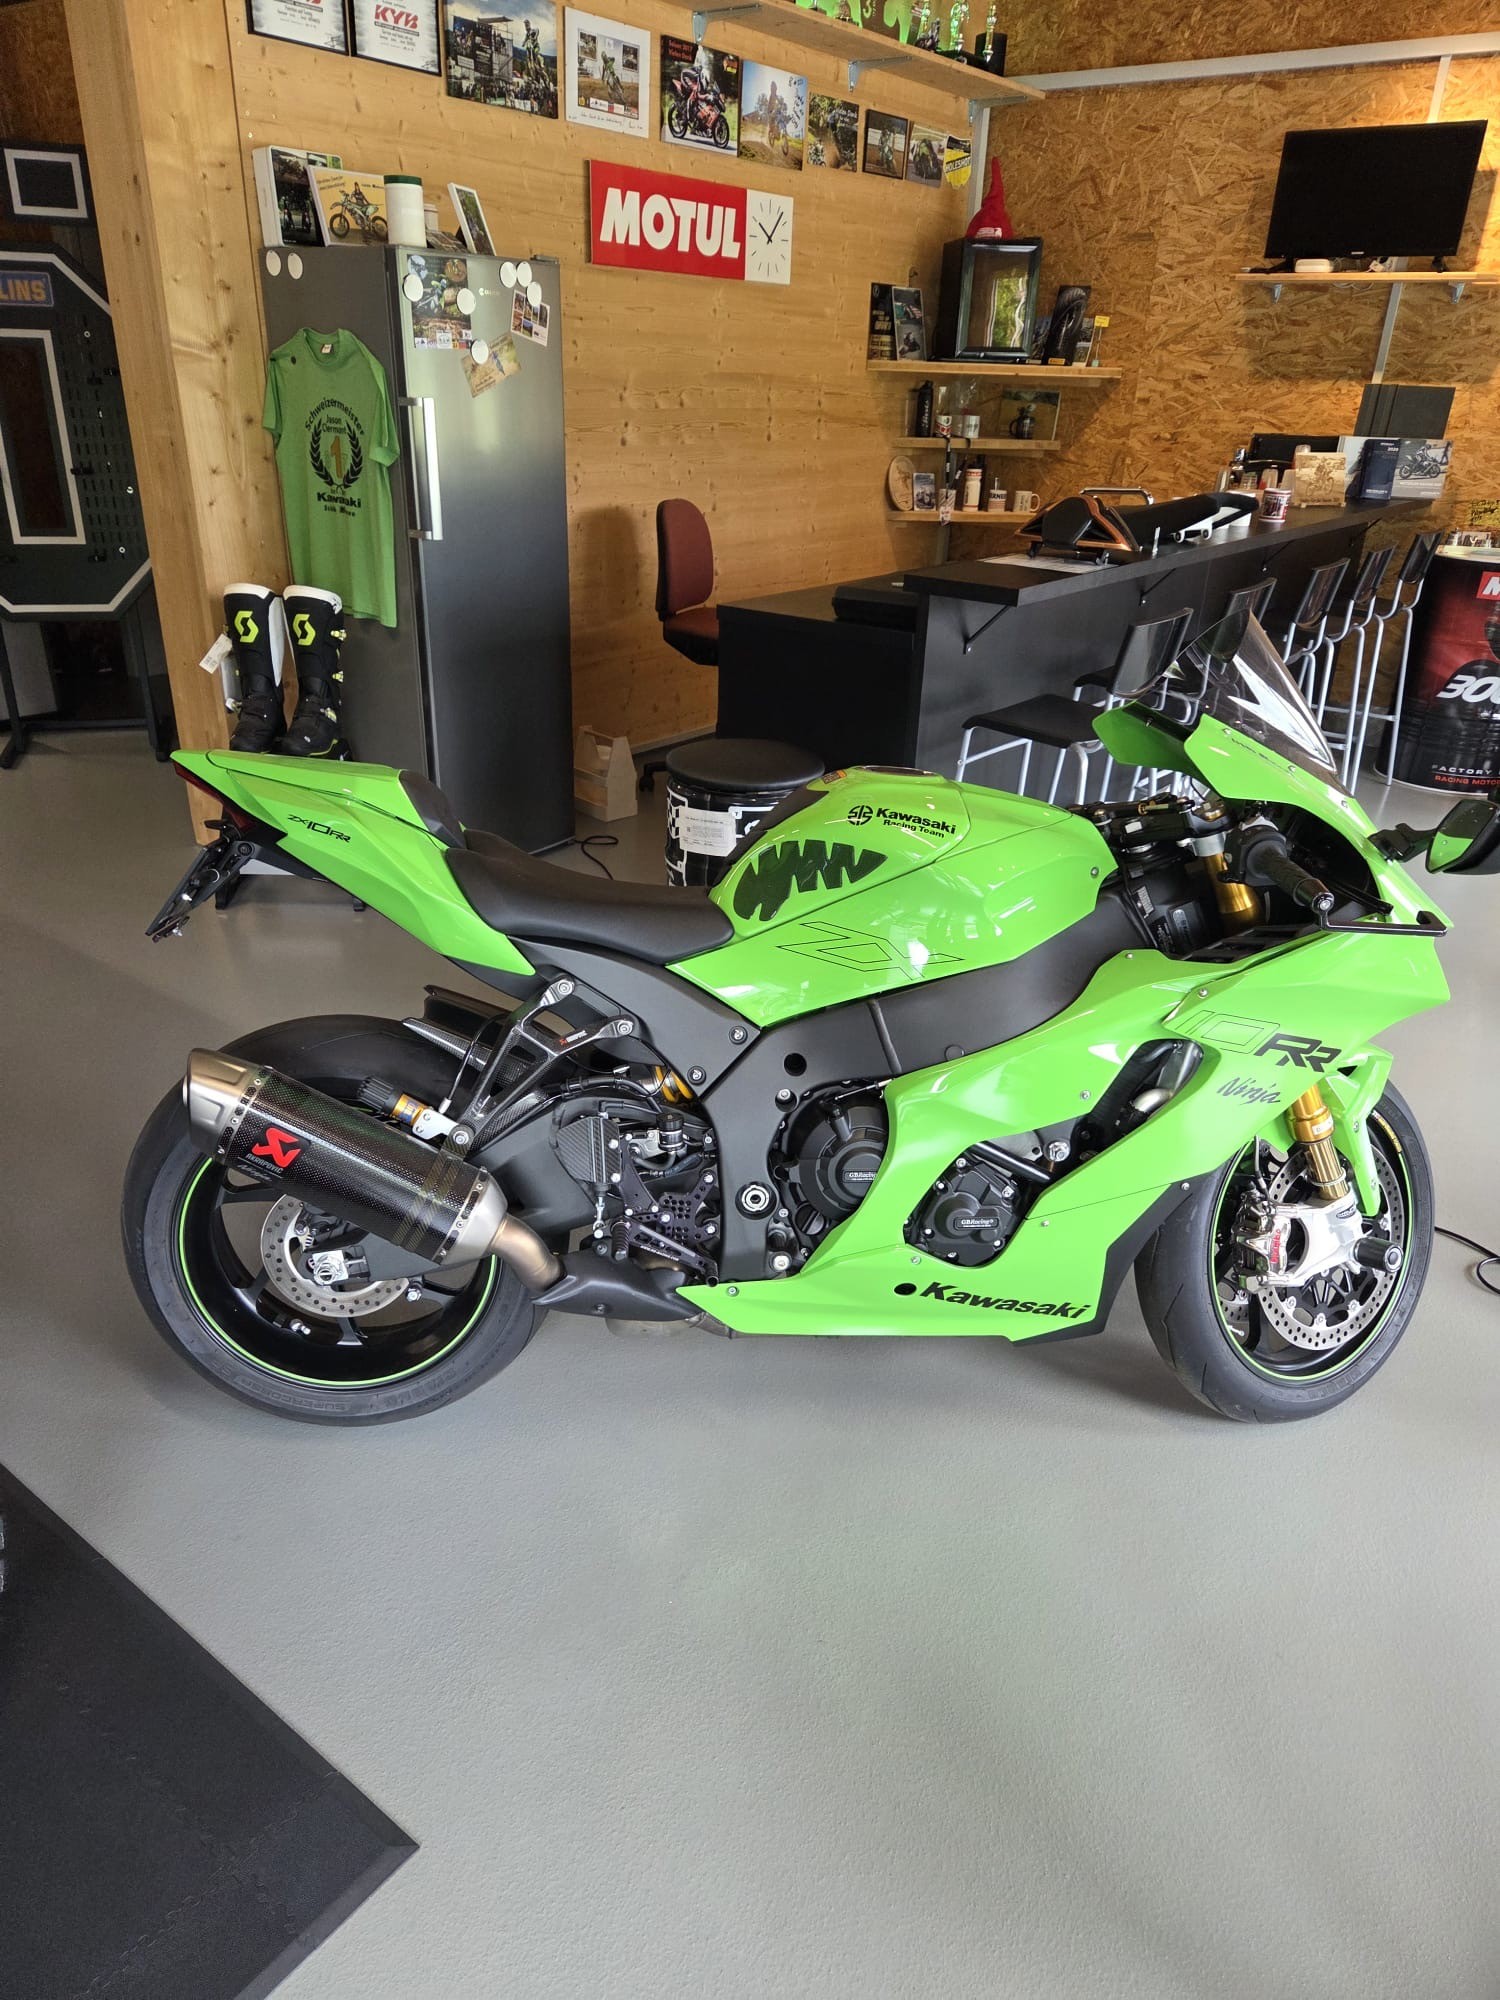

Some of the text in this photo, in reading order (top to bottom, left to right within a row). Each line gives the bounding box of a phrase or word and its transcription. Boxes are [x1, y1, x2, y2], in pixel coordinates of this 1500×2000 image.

[375, 4, 418, 29] KYB
[600, 187, 741, 259] MOTUL
[1432, 765, 1492, 775] FACTORY
[1435, 775, 1469, 785] RACING
[876, 808, 956, 834] Kawasaki
[883, 820, 945, 838] Racing Team
[1216, 1077, 1281, 1105] Ninja
[920, 1281, 1091, 1319] Kawasaki
